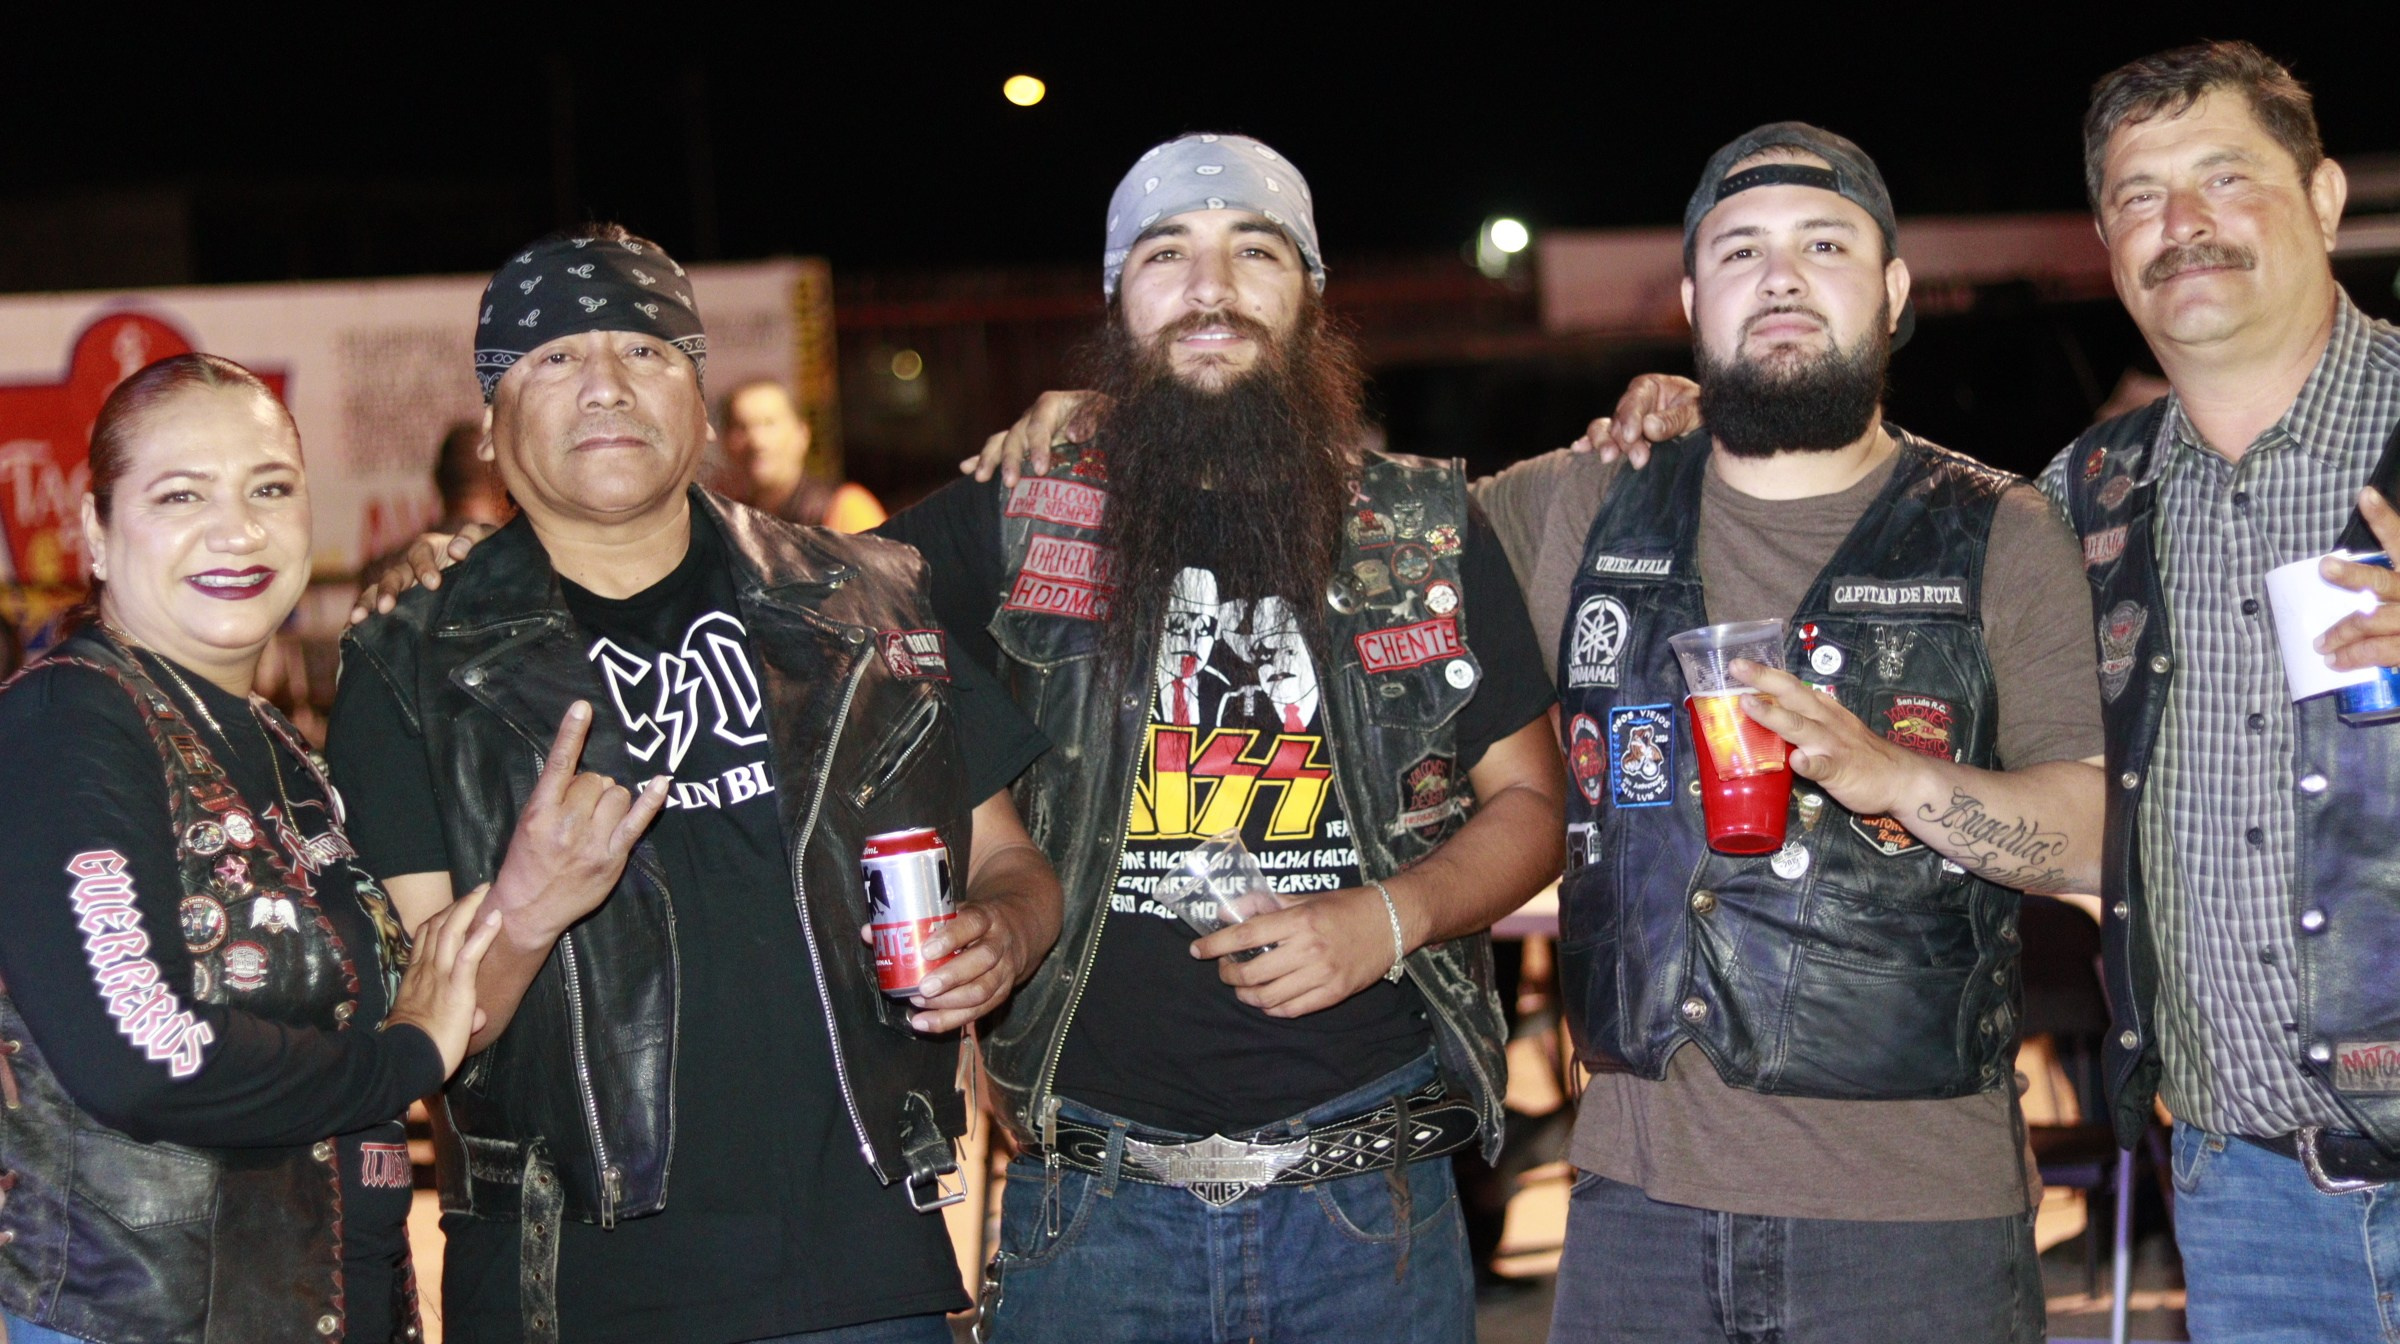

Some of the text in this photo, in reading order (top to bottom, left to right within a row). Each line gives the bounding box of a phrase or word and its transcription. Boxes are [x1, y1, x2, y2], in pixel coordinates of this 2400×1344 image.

[1834, 585, 1963, 605] CAPITAN DE RUTA
[1363, 624, 1458, 666] CHENTE
[1569, 664, 1617, 684] YAMAHA
[1896, 697, 1913, 707] San
[1913, 697, 1931, 708] Luis
[1612, 711, 1634, 732] OSOS
[1640, 709, 1671, 728] VIEJOS
[1877, 829, 1913, 850] Rally
[1122, 851, 1146, 870] ME
[1312, 848, 1359, 868] FALTA
[1208, 876, 1247, 896] QUE
[872, 925, 914, 958] ATE
[65, 849, 215, 1078] GUERREROS
[1195, 1182, 1241, 1204] CYCLES
